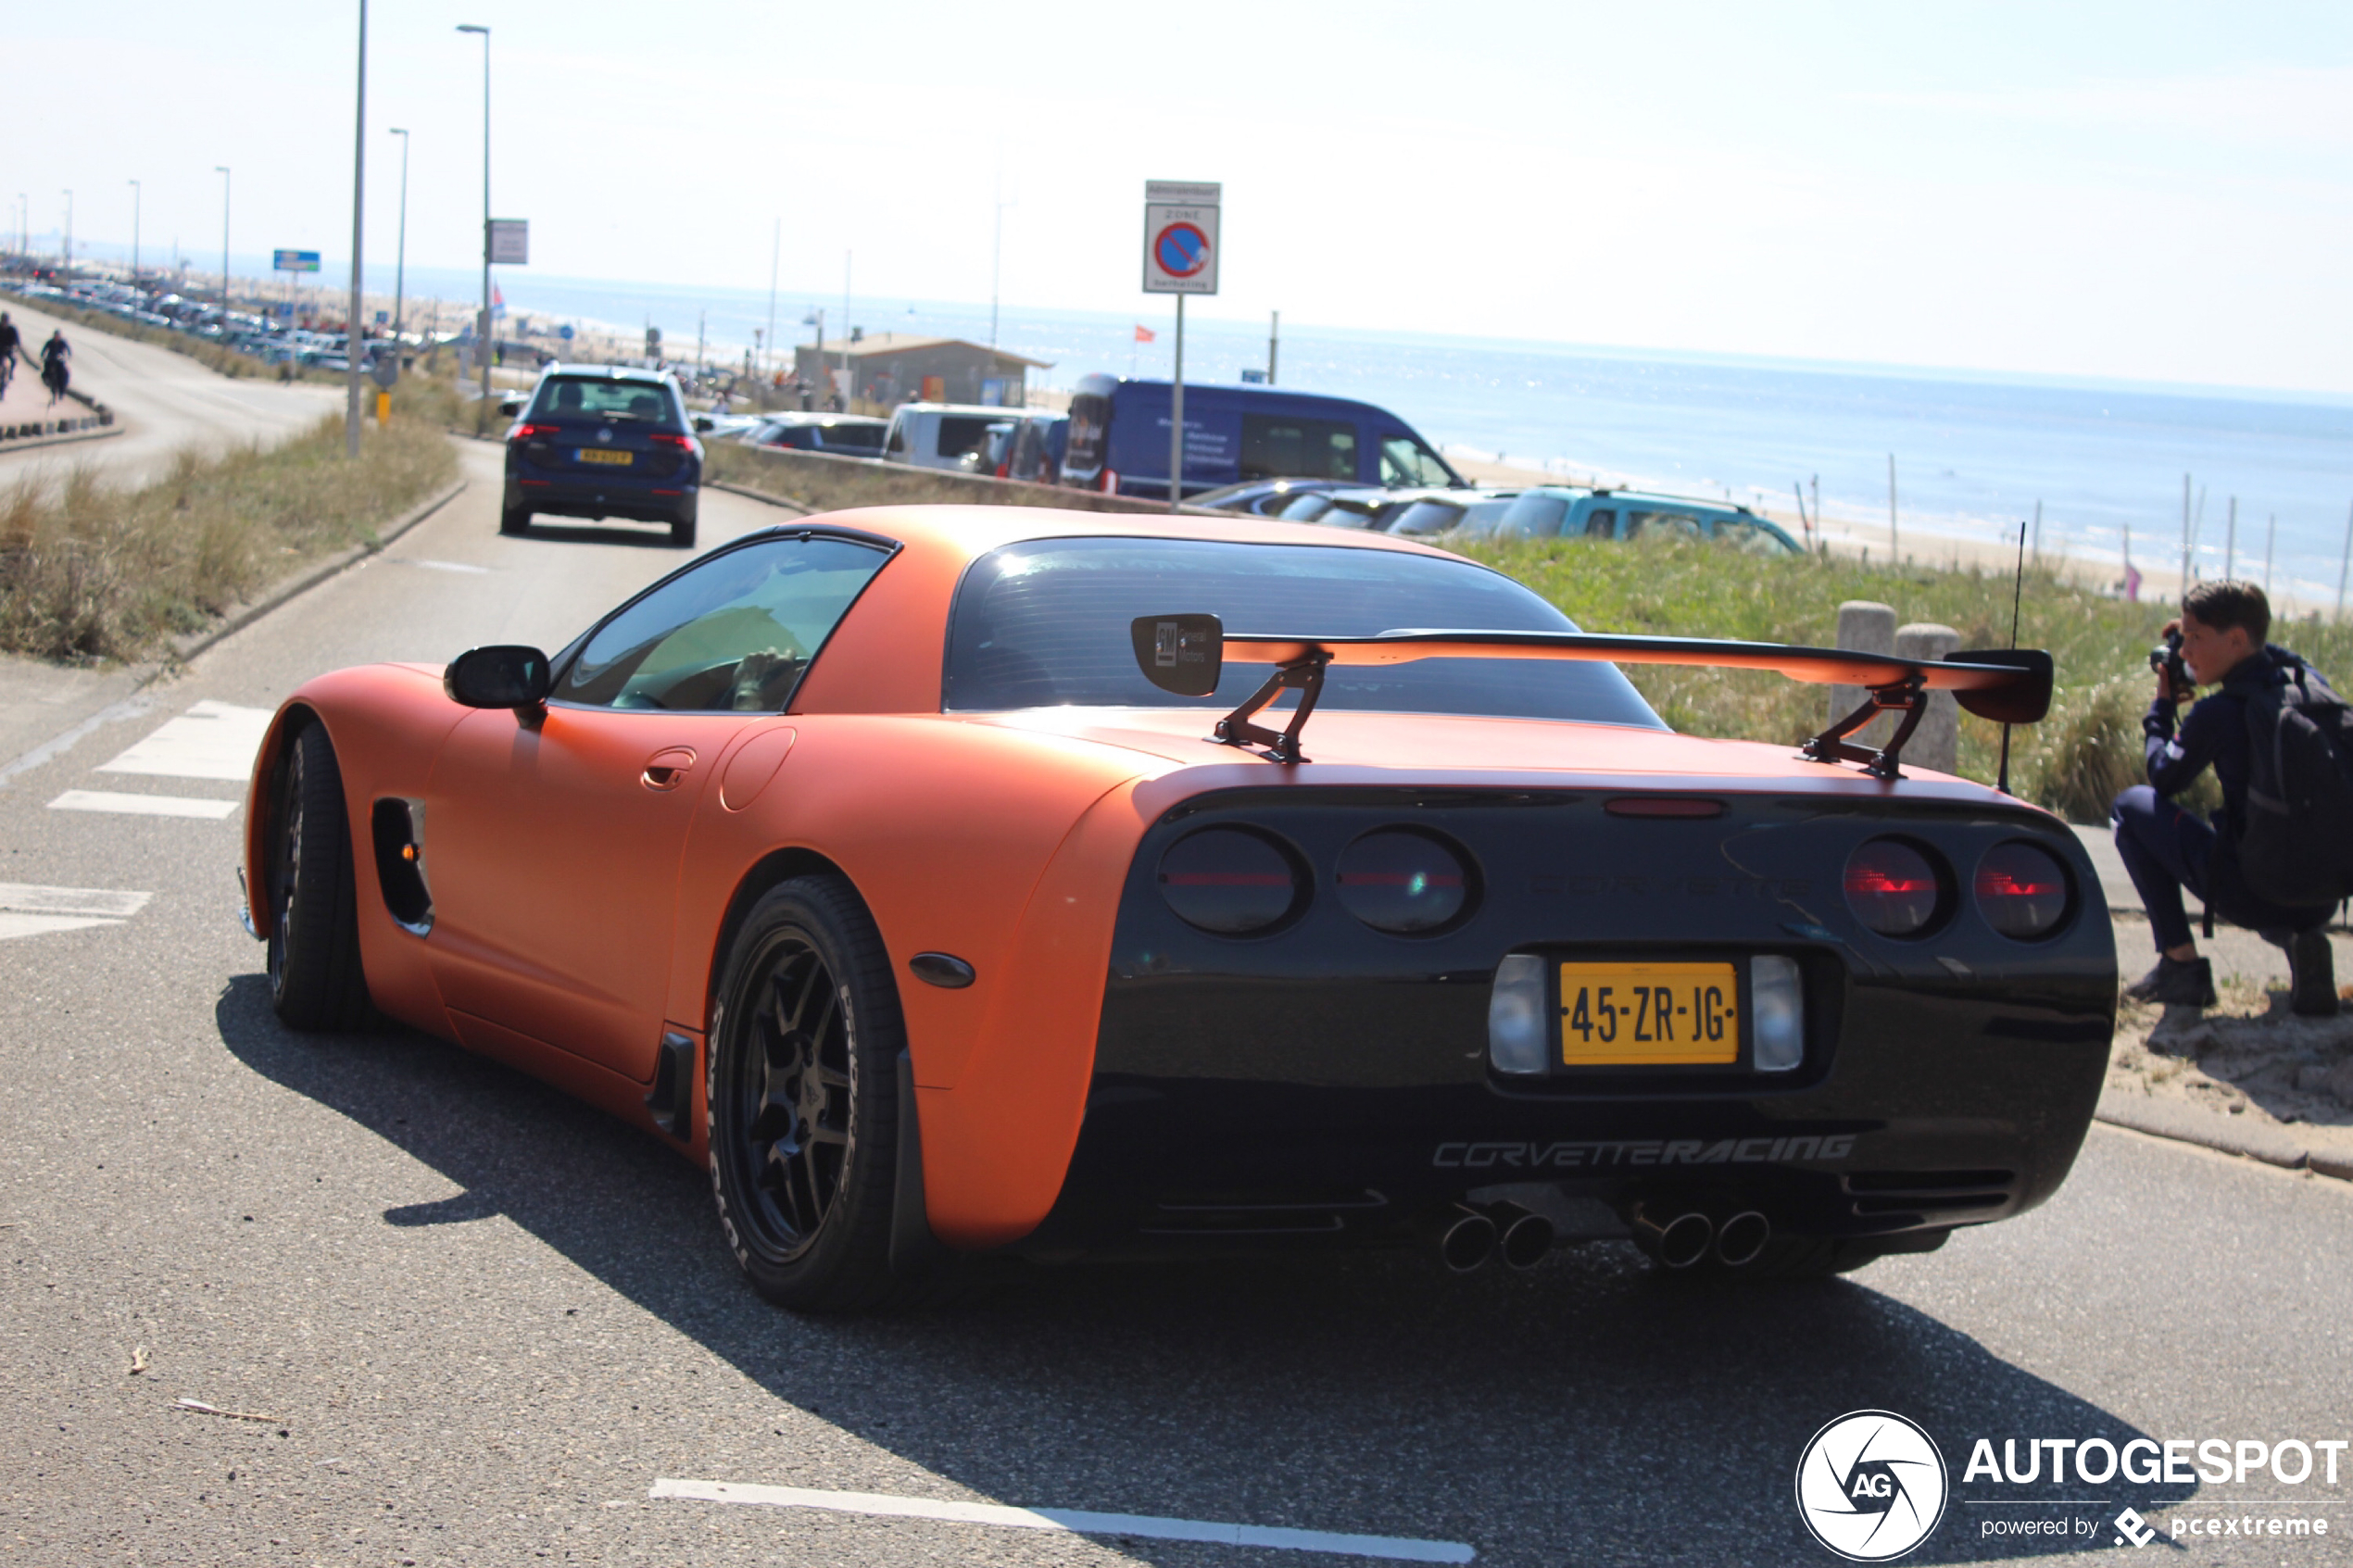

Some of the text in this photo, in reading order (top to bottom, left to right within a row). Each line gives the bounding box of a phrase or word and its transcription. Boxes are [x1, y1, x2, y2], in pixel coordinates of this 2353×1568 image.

[1165, 210, 1201, 220] ZONE
[1178, 648, 1205, 662] Motors
[1571, 985, 1724, 1043] 45-ZR-JG
